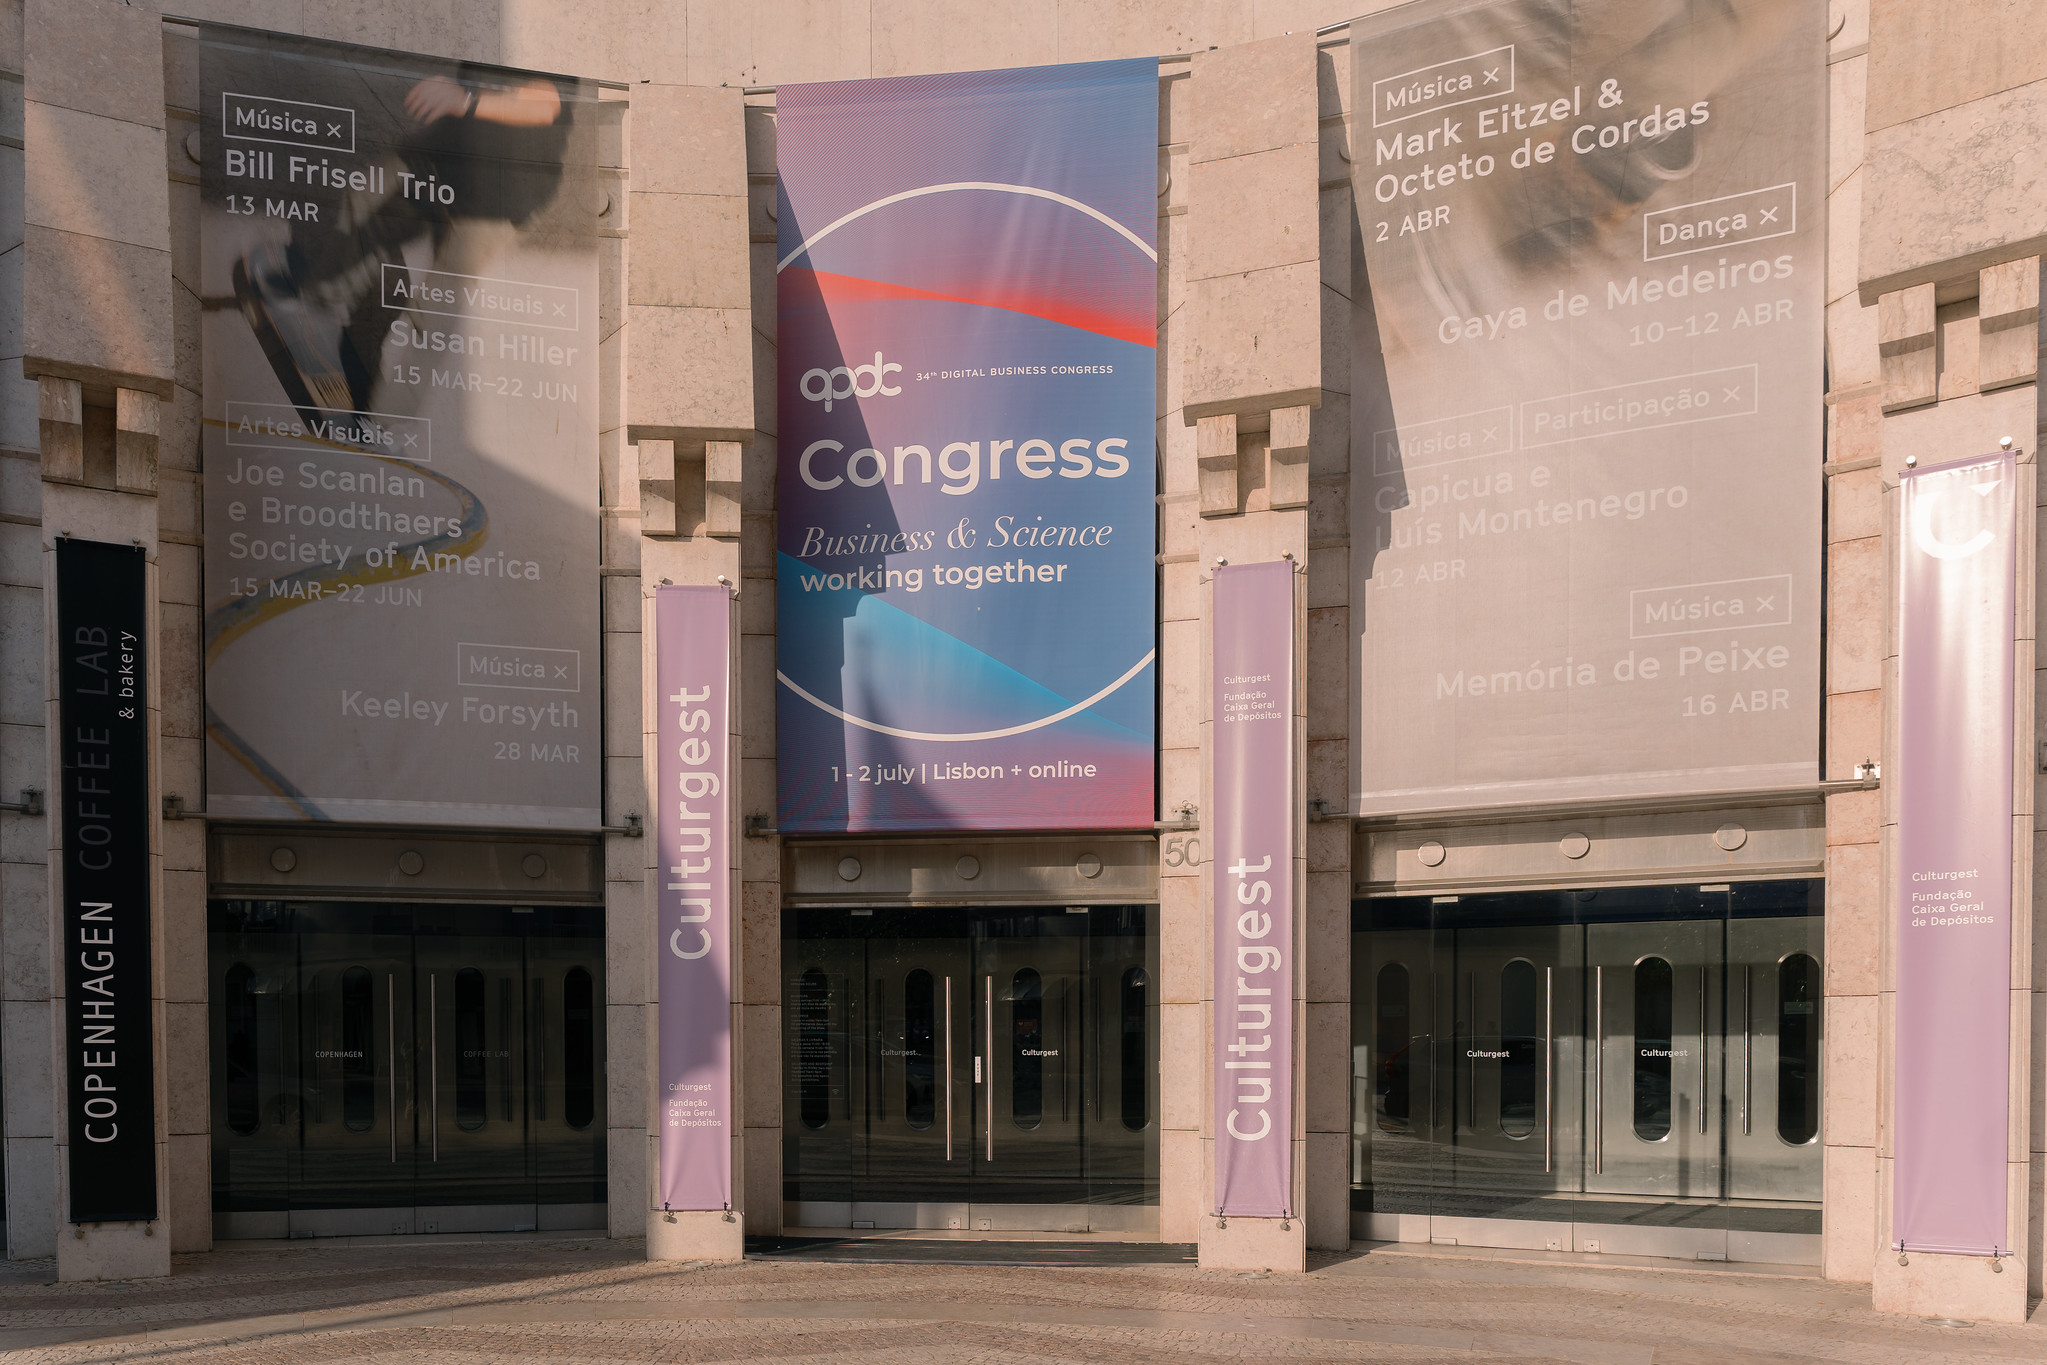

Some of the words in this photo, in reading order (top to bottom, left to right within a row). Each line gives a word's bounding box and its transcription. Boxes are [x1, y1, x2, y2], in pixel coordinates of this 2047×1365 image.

[1386, 73, 1473, 111] Música
[235, 105, 318, 136] Música
[1375, 120, 1462, 167] Mark
[1479, 87, 1581, 138] Eitzel
[1598, 78, 1623, 107] &
[1375, 153, 1495, 202] Octeto
[1511, 138, 1555, 169] de
[1571, 100, 1710, 155] Cordas
[226, 149, 273, 181] Bill
[289, 156, 384, 195] Frisell
[398, 172, 455, 206] Trio
[226, 195, 255, 215] 13
[266, 198, 319, 222] MAR
[1376, 222, 1388, 242] 2
[1400, 205, 1450, 237] ABR
[1660, 212, 1747, 246] Dança
[393, 278, 455, 305] Artes
[464, 286, 543, 316] Visuais
[1438, 305, 1528, 344] Gaya
[1544, 291, 1589, 321] de
[1608, 254, 1794, 311] Medeiros
[1733, 299, 1794, 330] ABR
[390, 320, 485, 356] Susan
[499, 334, 577, 367] Hiller
[394, 365, 421, 384] 15
[532, 379, 577, 404] JUN
[941, 368, 986, 380] DIGITAL
[990, 365, 1047, 377] BUSINESS
[1051, 364, 1113, 375] CONGRESS
[1534, 388, 1710, 432] Participação
[237, 414, 301, 439] Artes
[310, 419, 394, 447] Visuais
[1386, 431, 1471, 461] Música
[227, 457, 284, 487] Joe
[298, 464, 424, 498] Scanlan
[798, 436, 1130, 496] Congress
[1375, 471, 1513, 514] Capicua
[1530, 465, 1550, 486] e
[227, 501, 246, 520] e
[262, 496, 462, 538] Broodthaers
[1375, 514, 1442, 550] Luís
[1458, 485, 1688, 539] Montenegro
[797, 525, 935, 559] Business
[947, 517, 976, 550] &
[988, 515, 1112, 550] Science
[228, 532, 352, 570] Society
[365, 538, 398, 568] of
[411, 547, 540, 581] America
[800, 564, 922, 593] working
[933, 559, 1067, 589] together
[1375, 568, 1404, 590] 12
[1415, 559, 1465, 582] ABR
[229, 577, 257, 596] 15
[374, 584, 422, 607] JUN
[1646, 596, 1744, 624] Música
[75, 626, 108, 696] LAB
[118, 630, 137, 698] bakery
[470, 655, 545, 679] Música
[1436, 657, 1596, 700] Memória
[1613, 652, 1660, 682] de
[1680, 640, 1790, 677] Peixe
[1224, 674, 1271, 684] Culturgest
[341, 690, 448, 726] Keeley
[462, 697, 578, 730] Forsyth
[1224, 691, 1266, 701] Fundação
[1224, 703, 1248, 712] Caixa
[1251, 700, 1274, 709] Geral
[1682, 696, 1716, 717] 16
[1729, 689, 1789, 713] ABR
[118, 706, 134, 720] &
[1238, 712, 1282, 722] Depósitos
[494, 742, 520, 760] 28
[530, 743, 579, 764] MAR
[832, 766, 838, 782] 1
[859, 764, 871, 782] 2
[875, 763, 915, 786] july
[934, 761, 1004, 782] Lisbon
[1011, 765, 1022, 777] +
[1028, 760, 1096, 779] online
[77, 726, 112, 870] COFFEE
[668, 685, 720, 960] Culturgest
[1912, 868, 1978, 882] Culturgest
[1912, 890, 1972, 901] Fundação
[1912, 904, 1945, 914] Caixa
[1950, 901, 1984, 912] Geral
[1912, 918, 1926, 927] de
[1931, 914, 1994, 926] Depósitos
[1225, 854, 1282, 1141] Culturgest
[80, 902, 118, 1144] COPENHAGEN
[464, 1050, 491, 1058] COFFEE
[495, 1050, 509, 1058] LAB
[880, 1049, 916, 1057] Culturgest
[1022, 1049, 1058, 1057] Culturgest
[1466, 1050, 1510, 1059] Culturgest
[1640, 1048, 1688, 1058] Culturgest
[669, 1083, 712, 1092] Culturgest
[669, 1099, 708, 1108] Fundação
[682, 1119, 721, 1127] Depósitos
